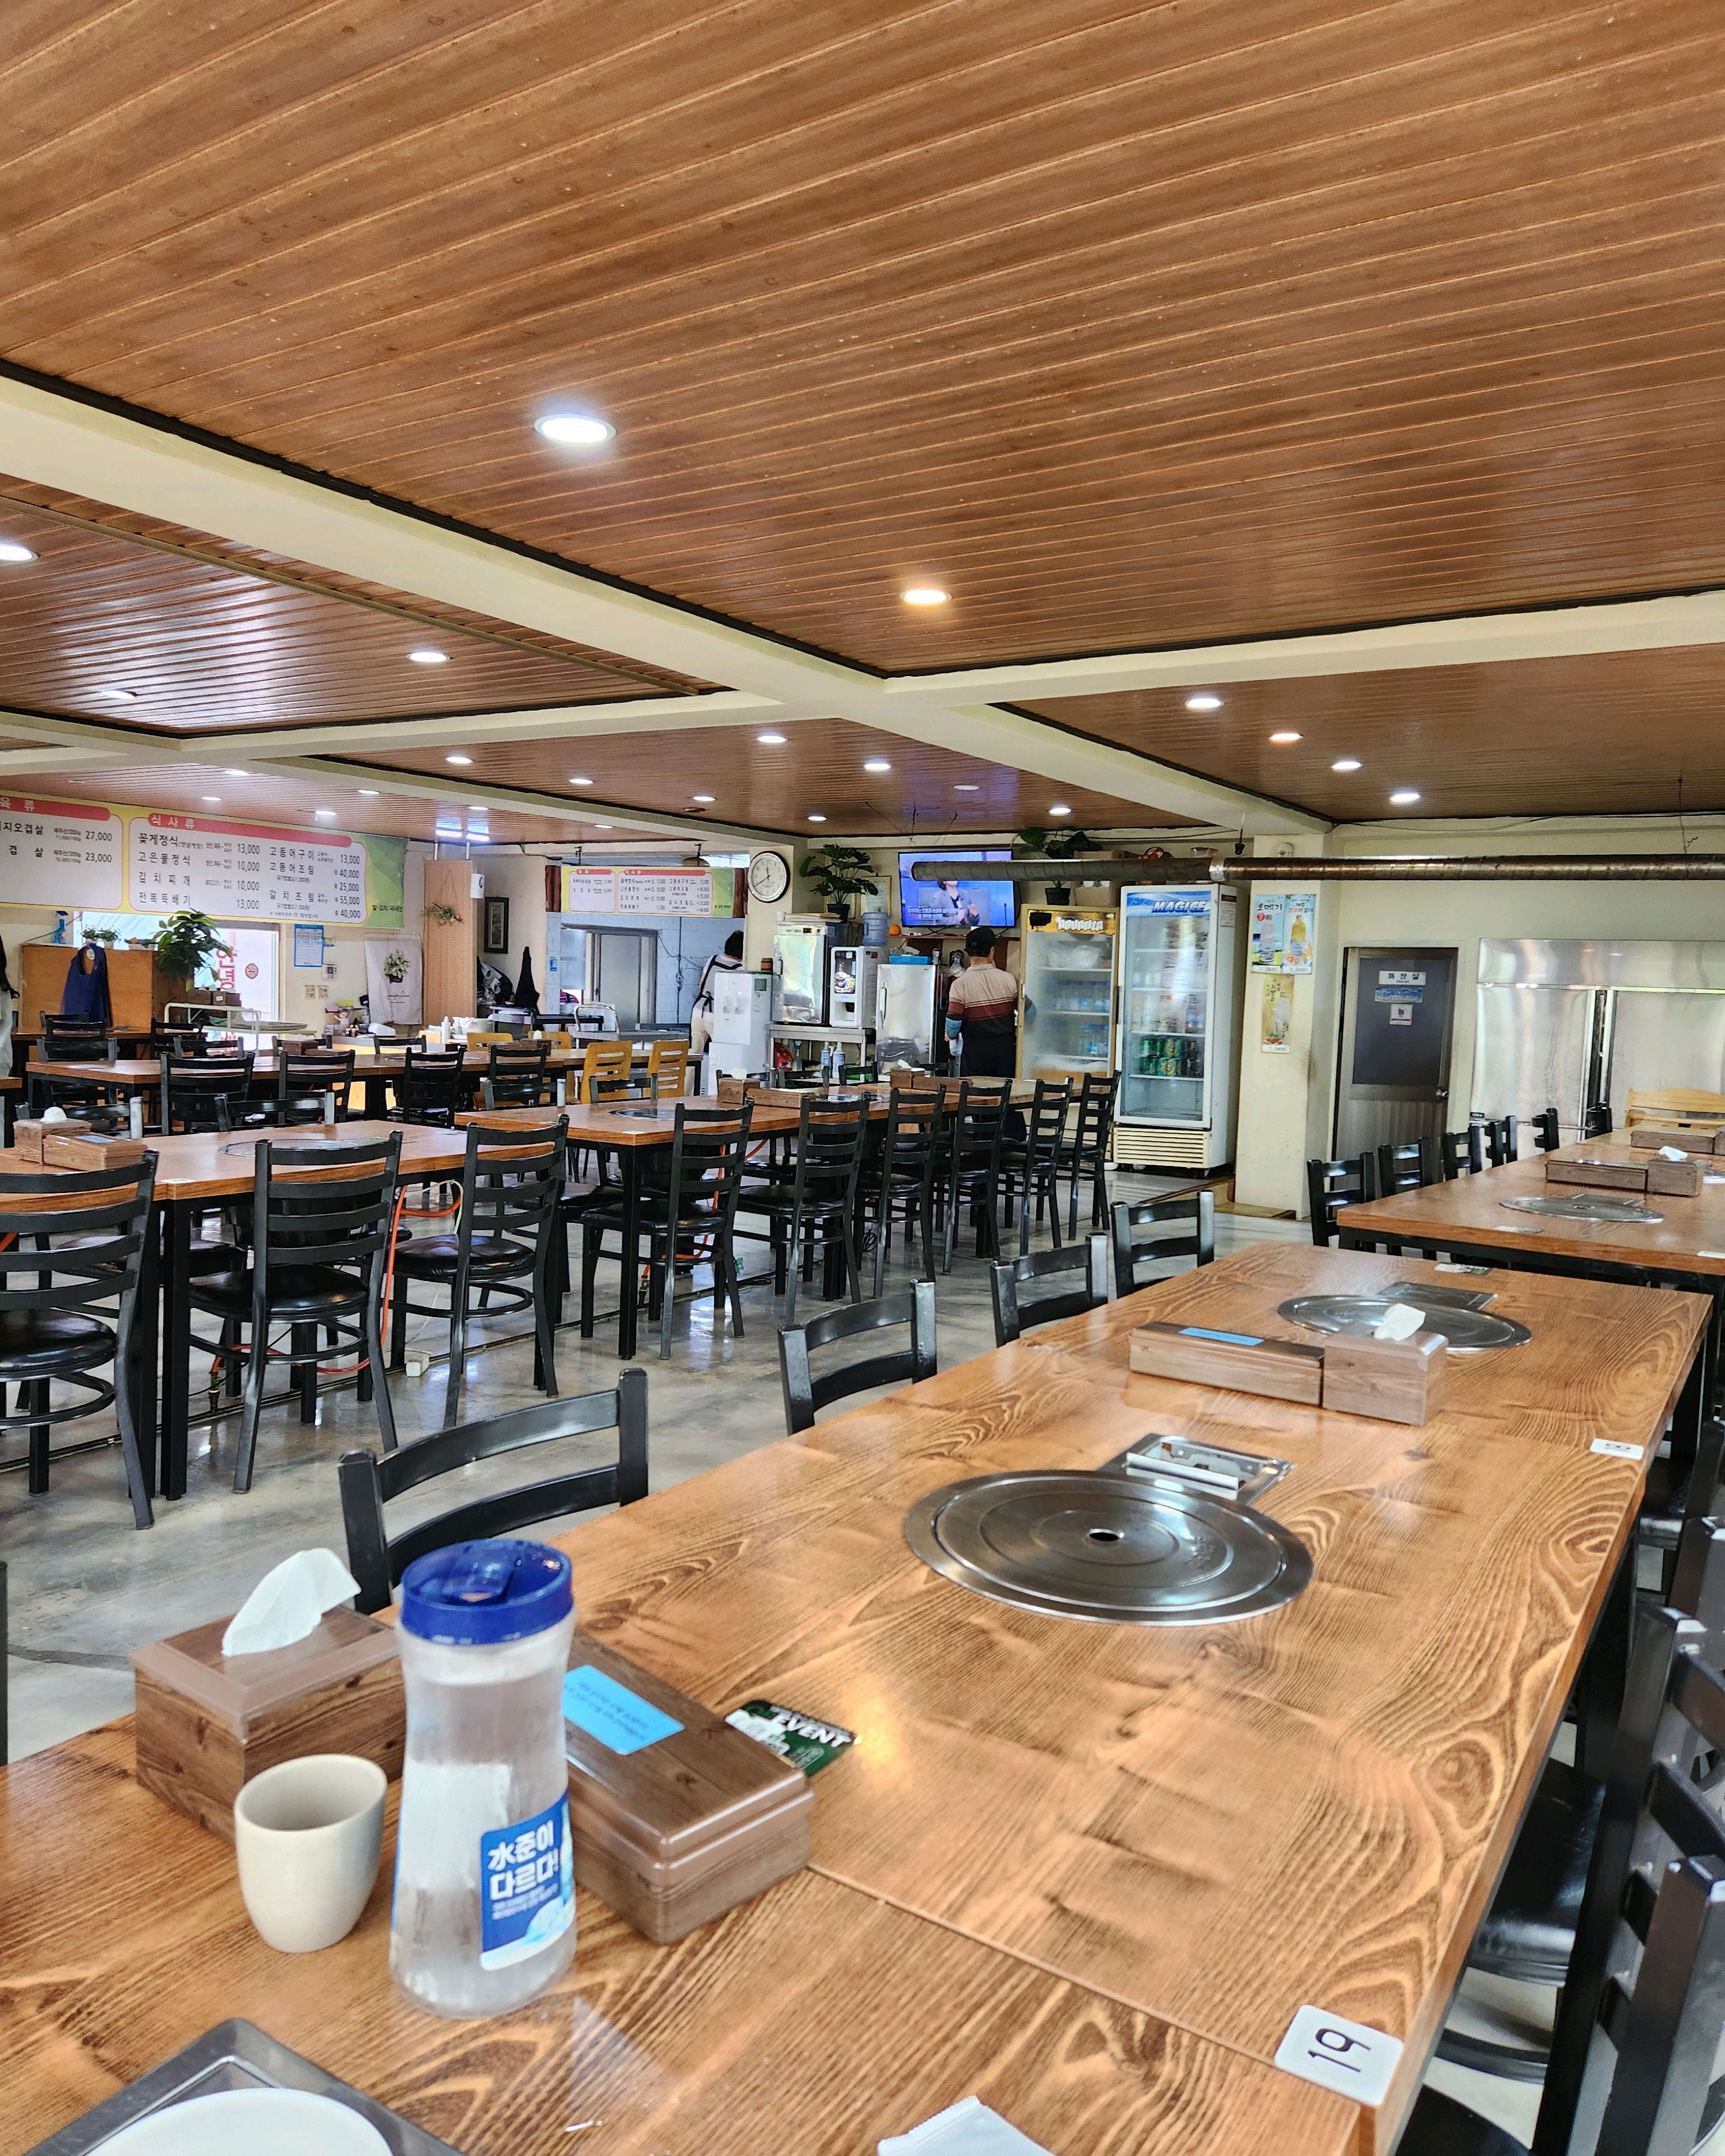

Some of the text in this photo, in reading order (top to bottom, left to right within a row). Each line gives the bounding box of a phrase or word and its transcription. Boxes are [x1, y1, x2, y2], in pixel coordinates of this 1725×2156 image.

[85, 831, 112, 842] 27,000
[138, 833, 178, 847] 꽃게정식
[237, 843, 260, 855] 13,000
[270, 847, 314, 861] 고등어구이
[85, 852, 112, 863] 23,000
[340, 854, 360, 865] 13,000
[237, 861, 260, 872] 10,000
[269, 862, 314, 875] 고등어조림
[339, 869, 359, 878] 40,000
[237, 880, 260, 892] 10,000
[339, 882, 359, 892] 25,000
[270, 890, 315, 903] 갈치조림
[340, 895, 360, 906] 55,000
[237, 899, 260, 910] 13,000
[340, 909, 361, 919] 40,000
[772, 1712, 852, 1748] EVENT
[490, 1847, 559, 1901] 다르다!
[1307, 2028, 1371, 2073] 19
